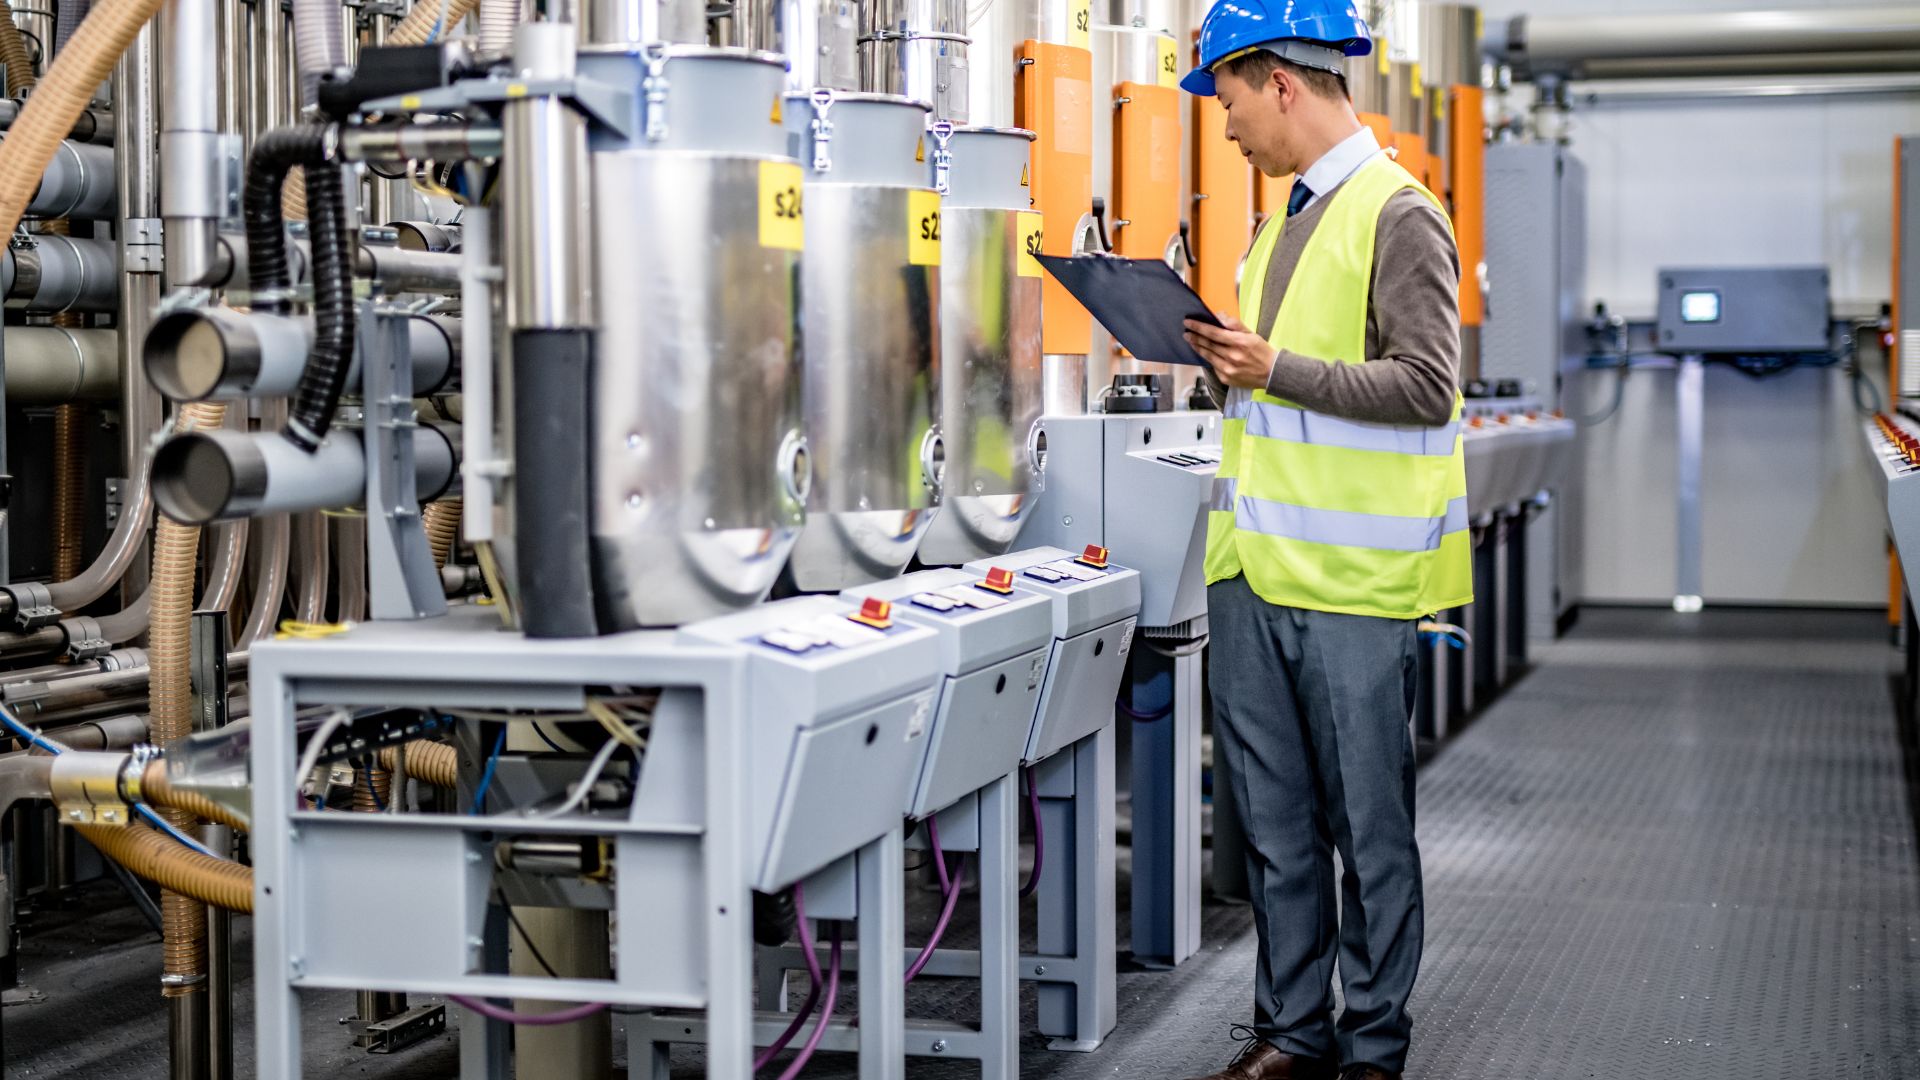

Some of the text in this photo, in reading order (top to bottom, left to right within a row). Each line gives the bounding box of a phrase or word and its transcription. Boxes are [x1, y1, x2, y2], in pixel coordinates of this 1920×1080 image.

[1076, 8, 1089, 32] s2
[1164, 52, 1177, 73] s2
[921, 211, 941, 241] s2
[1026, 229, 1043, 255] s2
